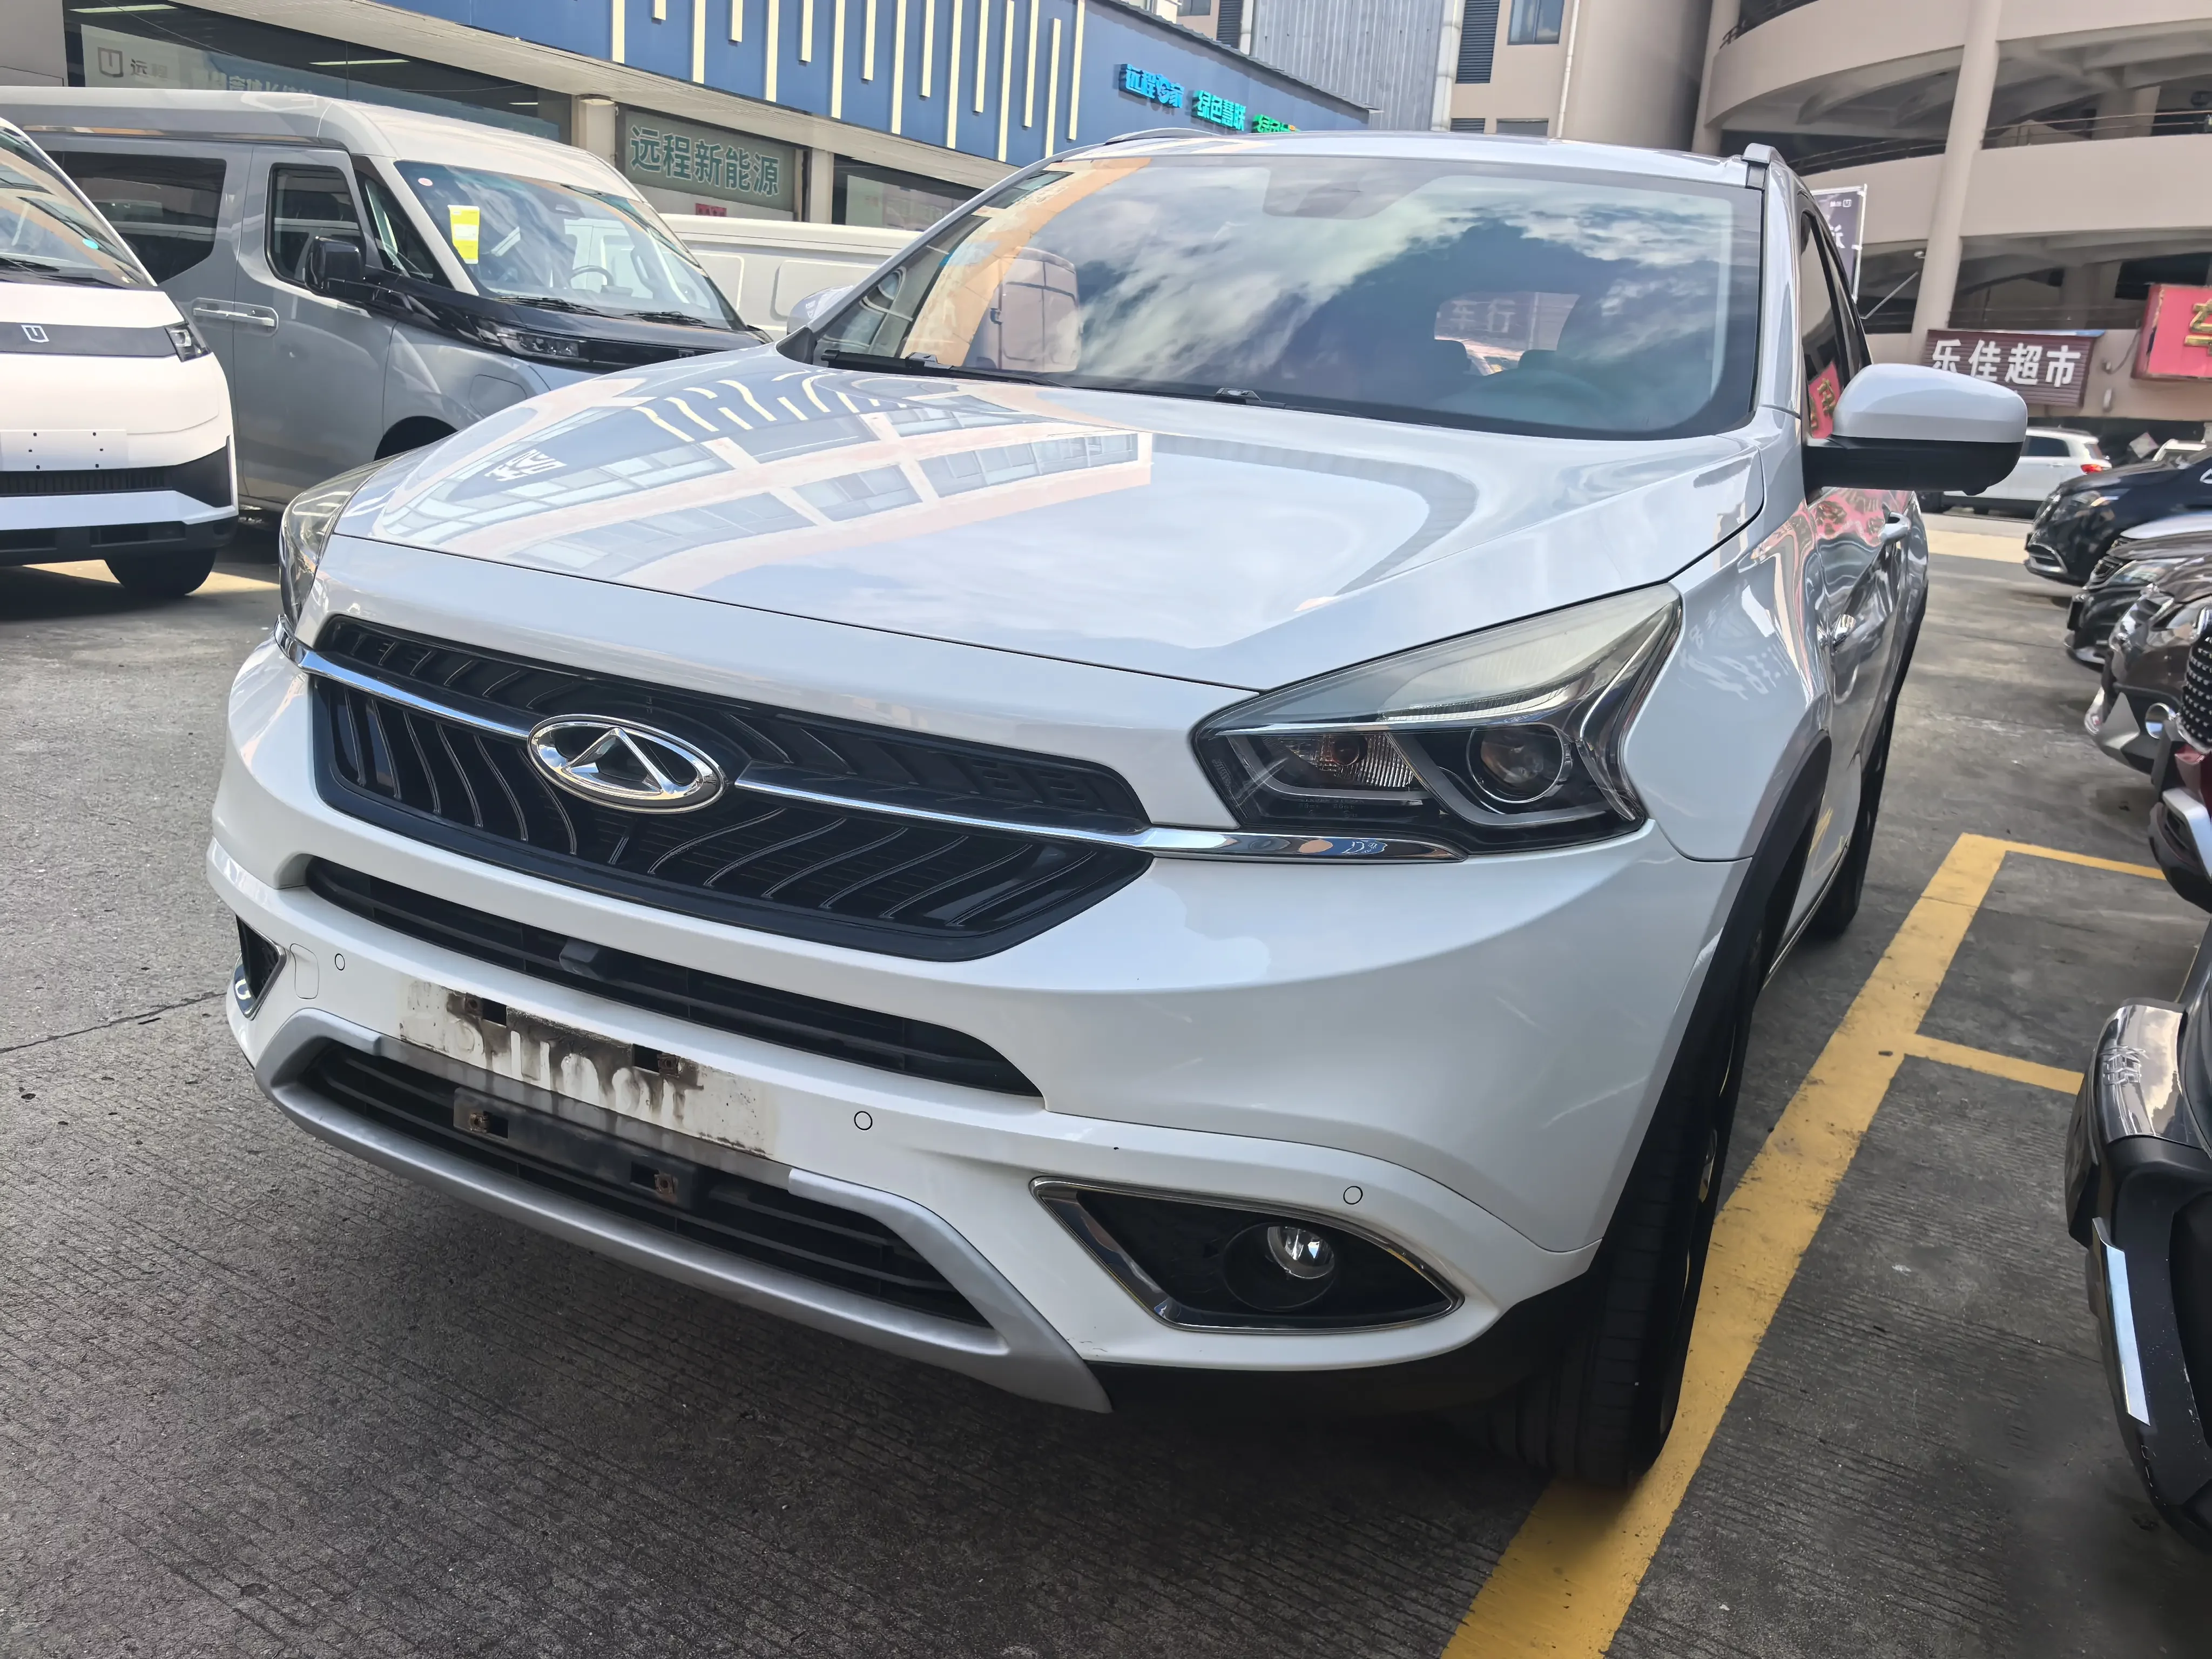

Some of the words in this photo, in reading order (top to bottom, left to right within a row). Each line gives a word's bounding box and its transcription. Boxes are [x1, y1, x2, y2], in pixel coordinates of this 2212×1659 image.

[630, 124, 780, 197] 远程新能源
[1932, 338, 2081, 388] 乐佳超市
